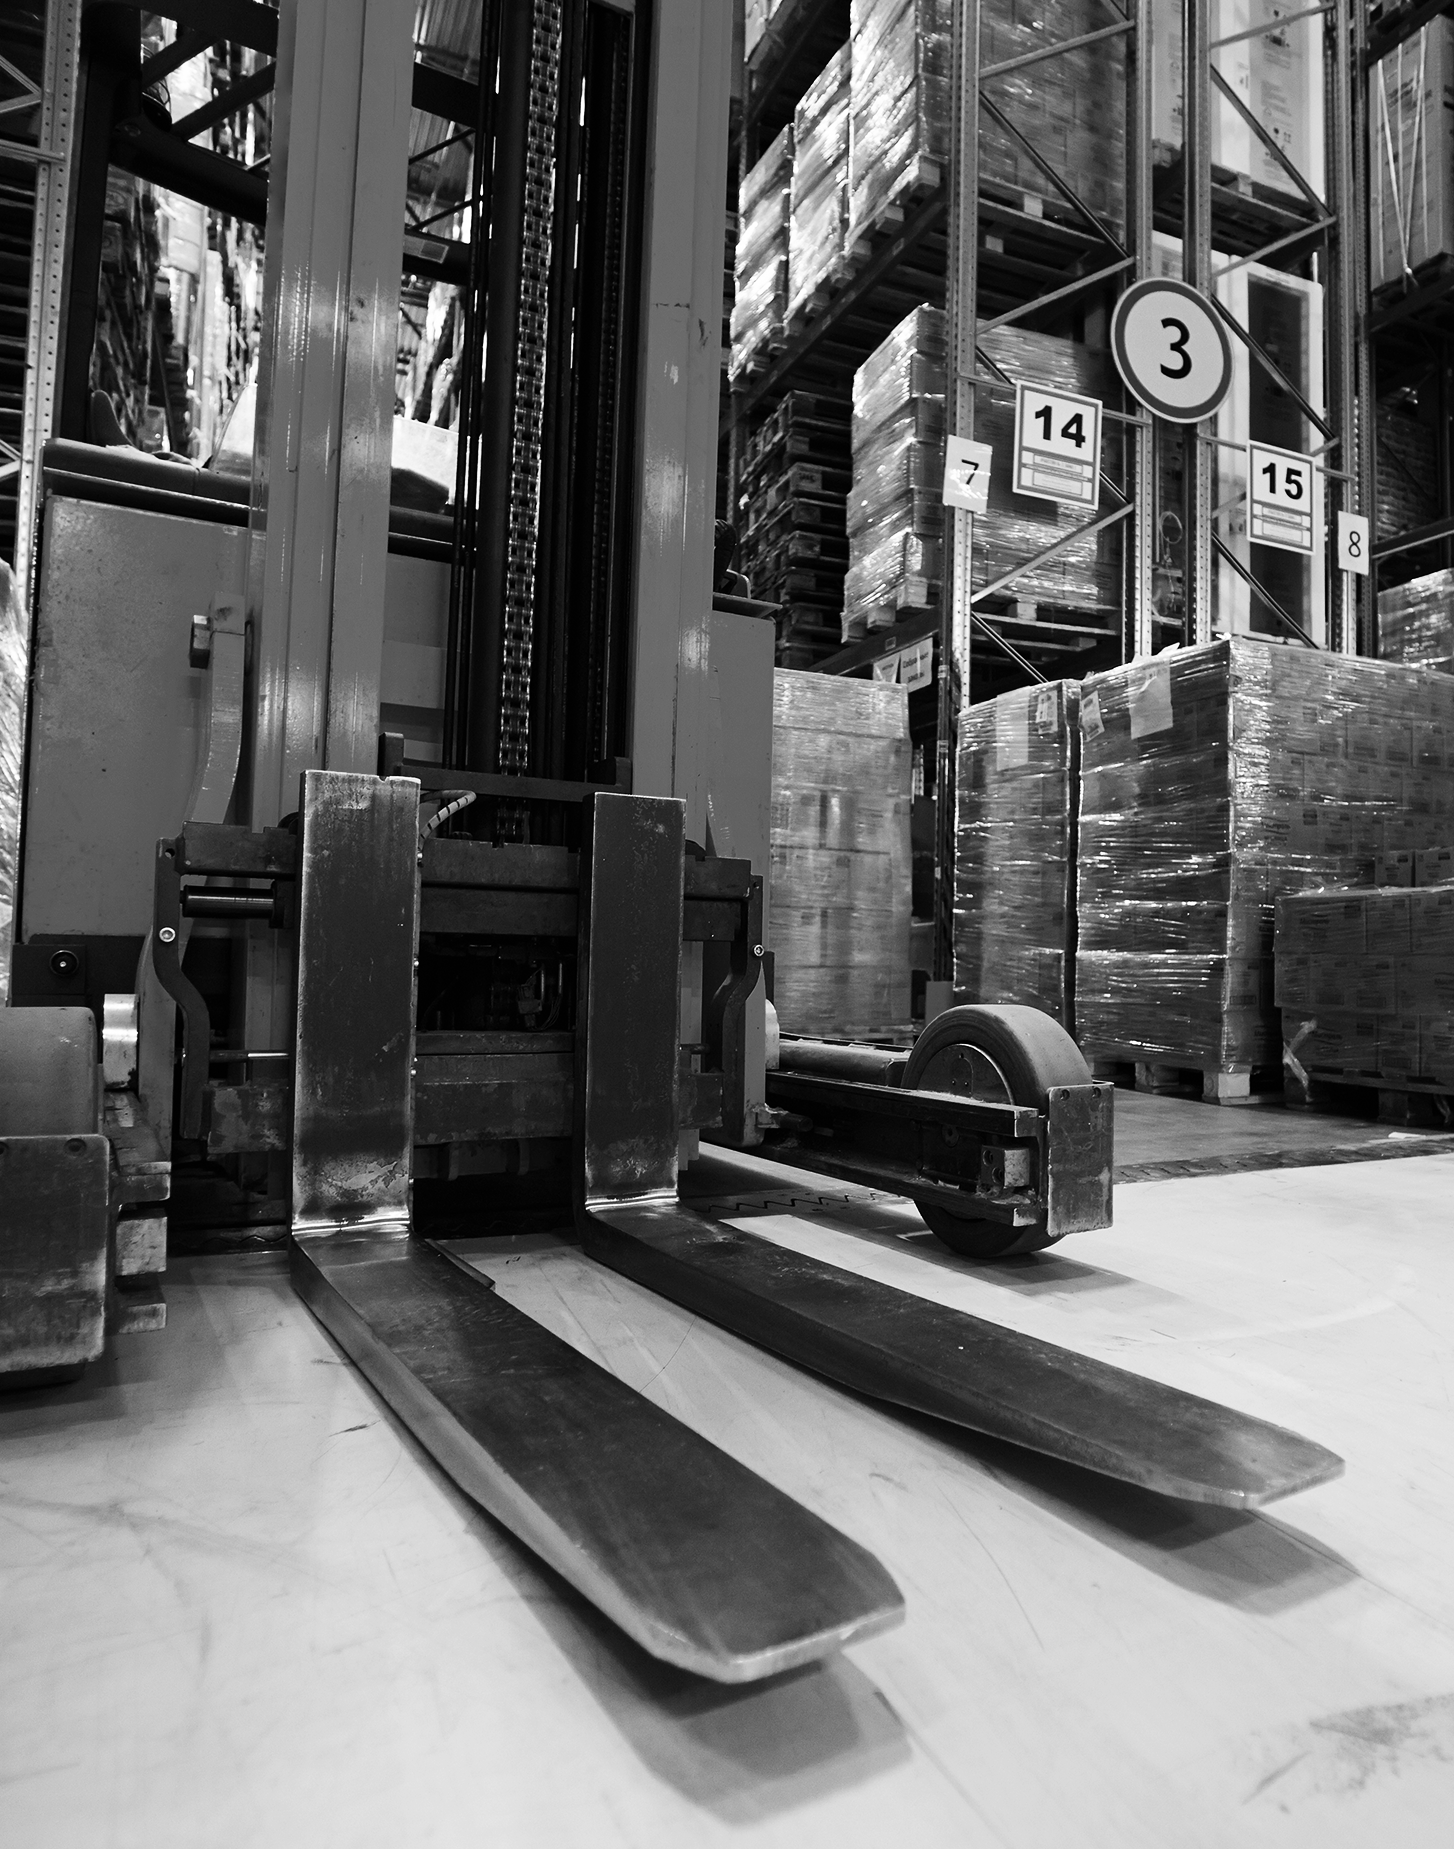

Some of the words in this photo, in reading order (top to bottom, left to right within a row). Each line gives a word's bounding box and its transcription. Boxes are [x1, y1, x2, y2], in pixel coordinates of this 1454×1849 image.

[1160, 317, 1193, 380] 3
[1034, 405, 1086, 449] 14
[961, 459, 979, 487] 7
[1262, 462, 1303, 500] 15
[1348, 530, 1362, 558] 8
